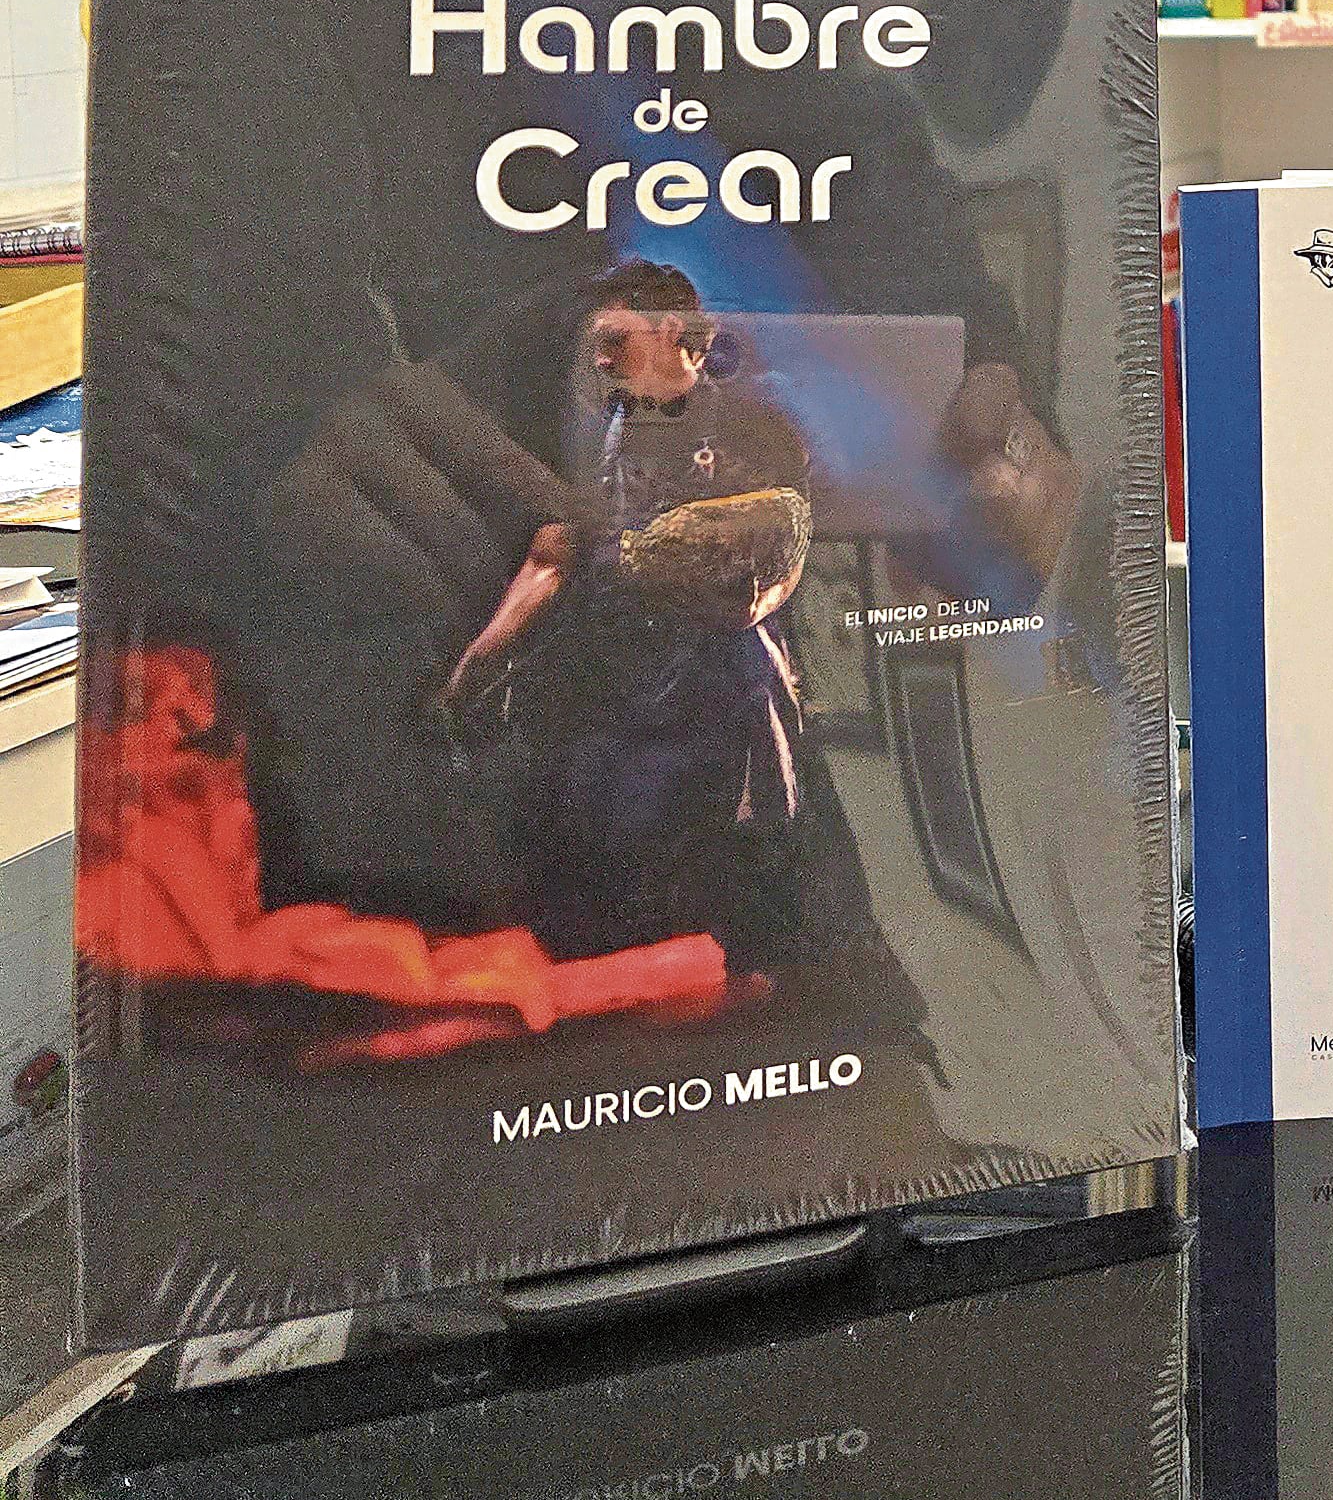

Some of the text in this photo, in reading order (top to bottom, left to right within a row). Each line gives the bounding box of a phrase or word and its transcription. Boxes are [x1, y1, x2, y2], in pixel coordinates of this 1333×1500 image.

[632, 87, 709, 134] de
[475, 126, 853, 232] Crear
[845, 598, 990, 628] EL INICIO DE UN
[875, 615, 1044, 647] VIAJE LEGENDARIO
[492, 1053, 863, 1144] MAURICIO MELLO
